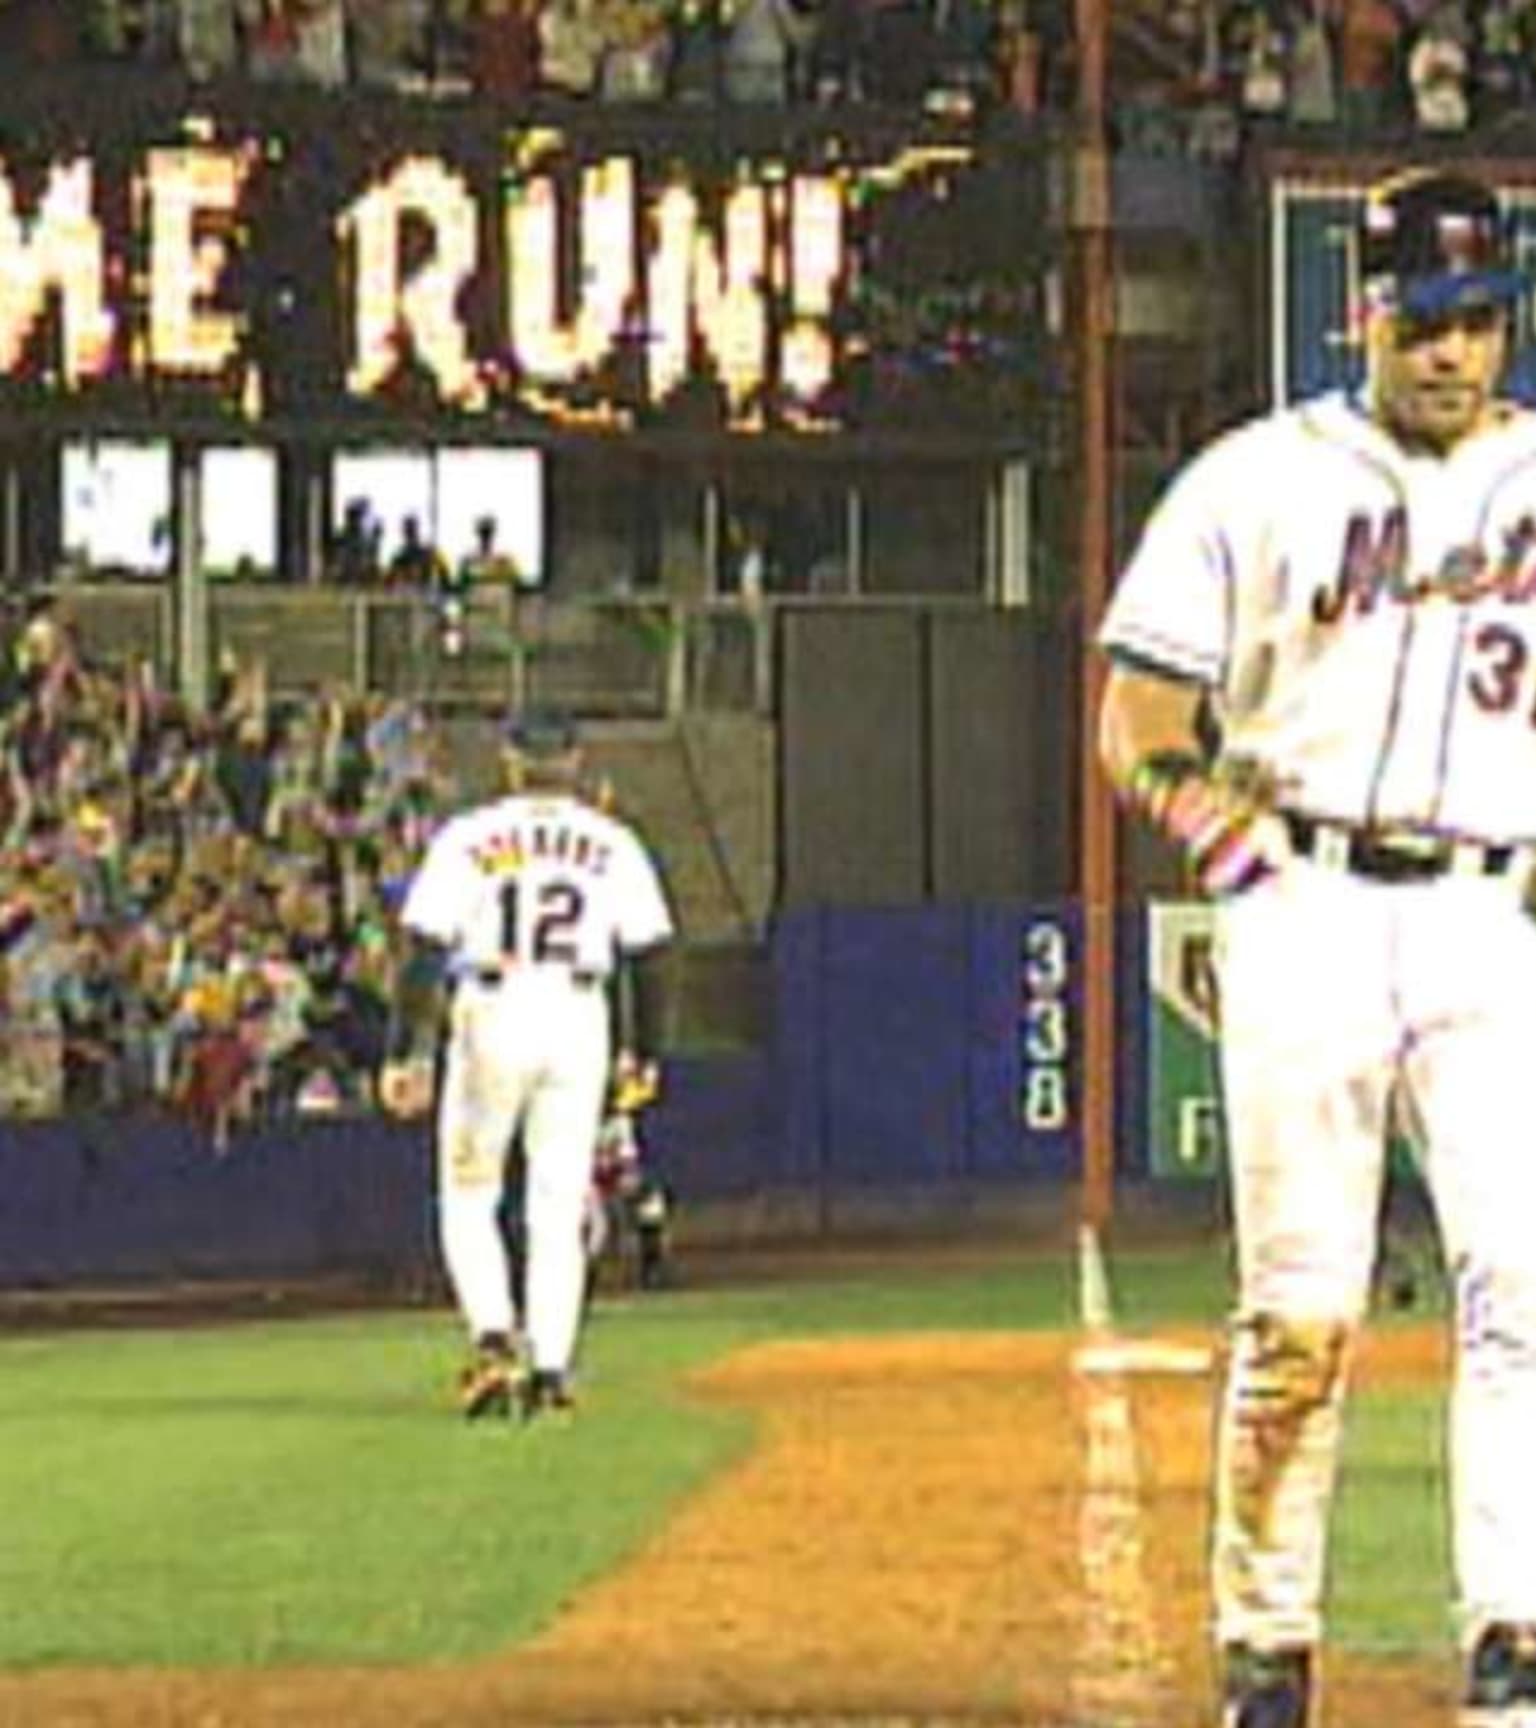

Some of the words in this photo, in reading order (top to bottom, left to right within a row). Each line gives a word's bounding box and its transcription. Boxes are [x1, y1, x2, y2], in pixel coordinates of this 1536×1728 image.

[343, 155, 845, 408] RUN!
[498, 878, 585, 963] 12
[1026, 920, 1067, 1132] 338
